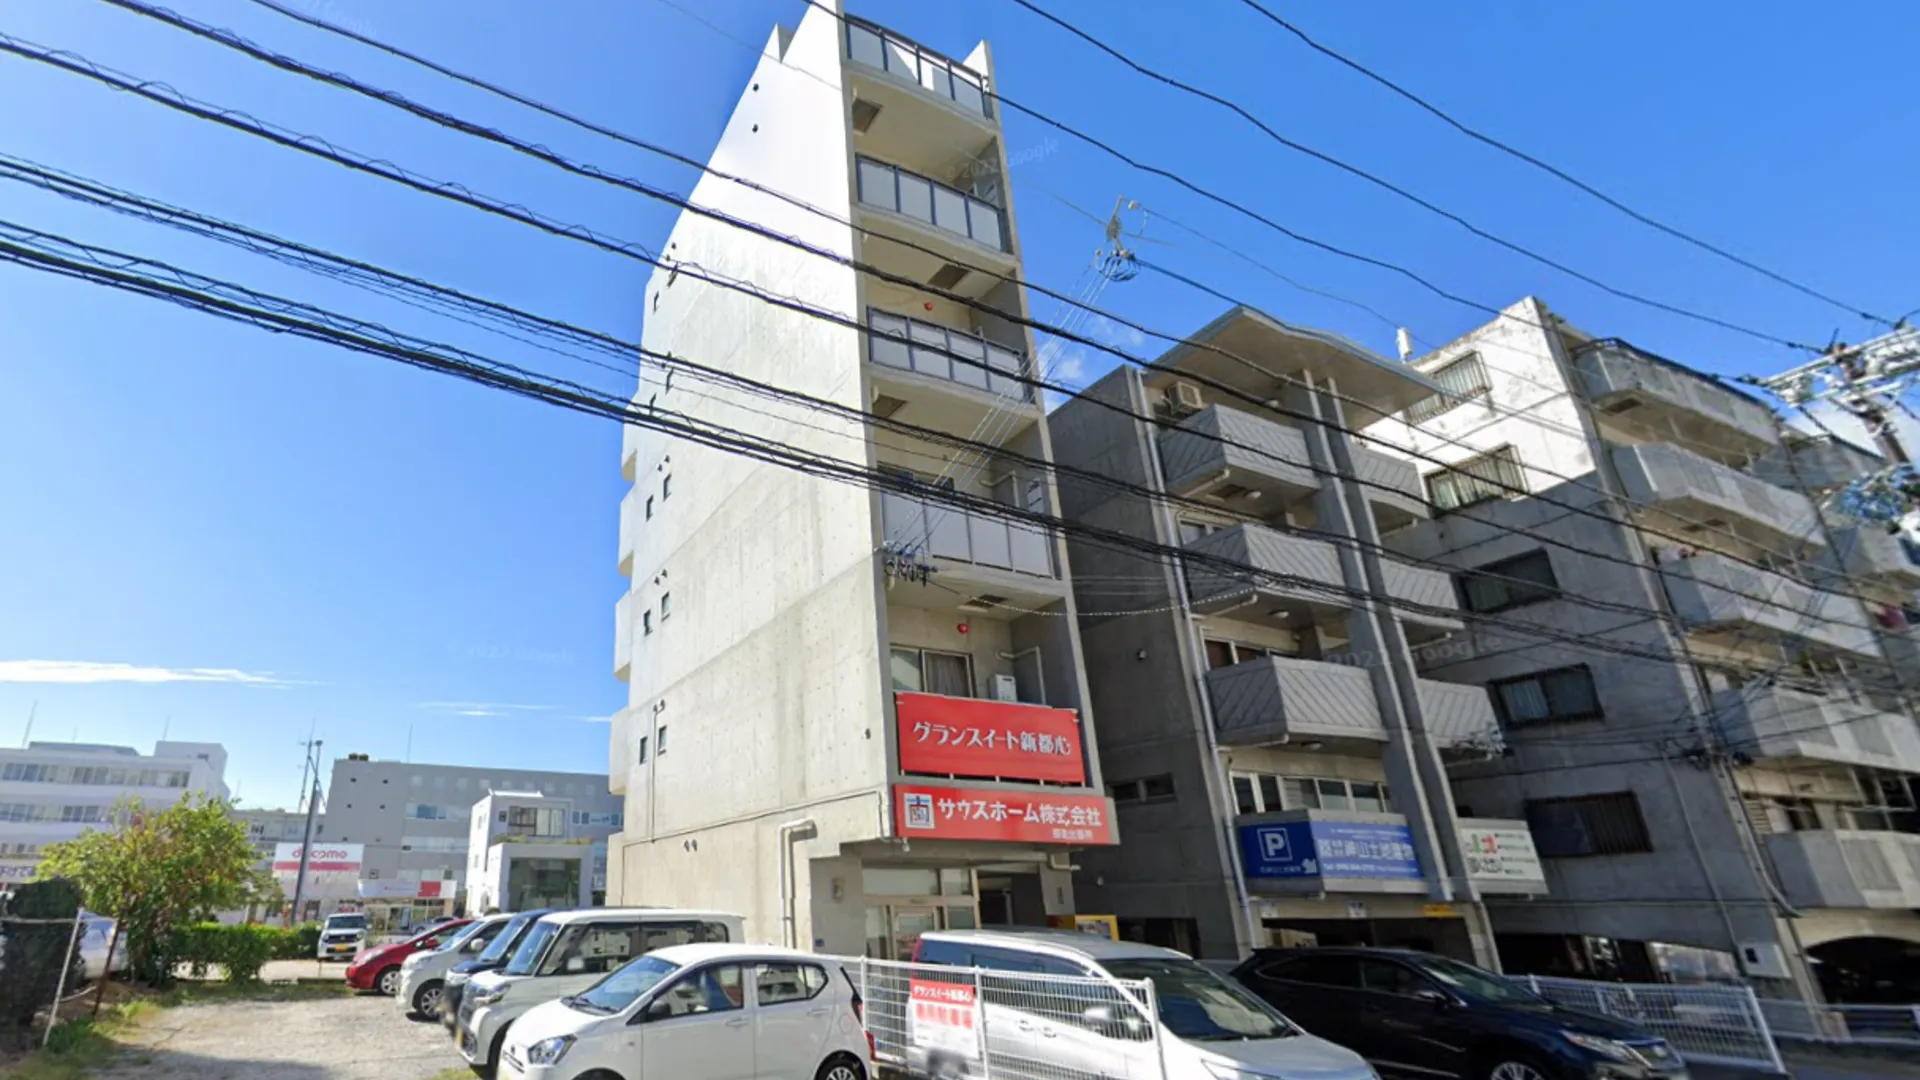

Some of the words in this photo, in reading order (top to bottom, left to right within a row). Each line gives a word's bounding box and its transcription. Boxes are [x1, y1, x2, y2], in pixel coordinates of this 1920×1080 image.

[913, 721, 1071, 756] グランスイート新都心
[938, 799, 1101, 827] サウスホーム株式会社
[292, 845, 348, 860] dcomo
[1264, 832, 1285, 857] P
